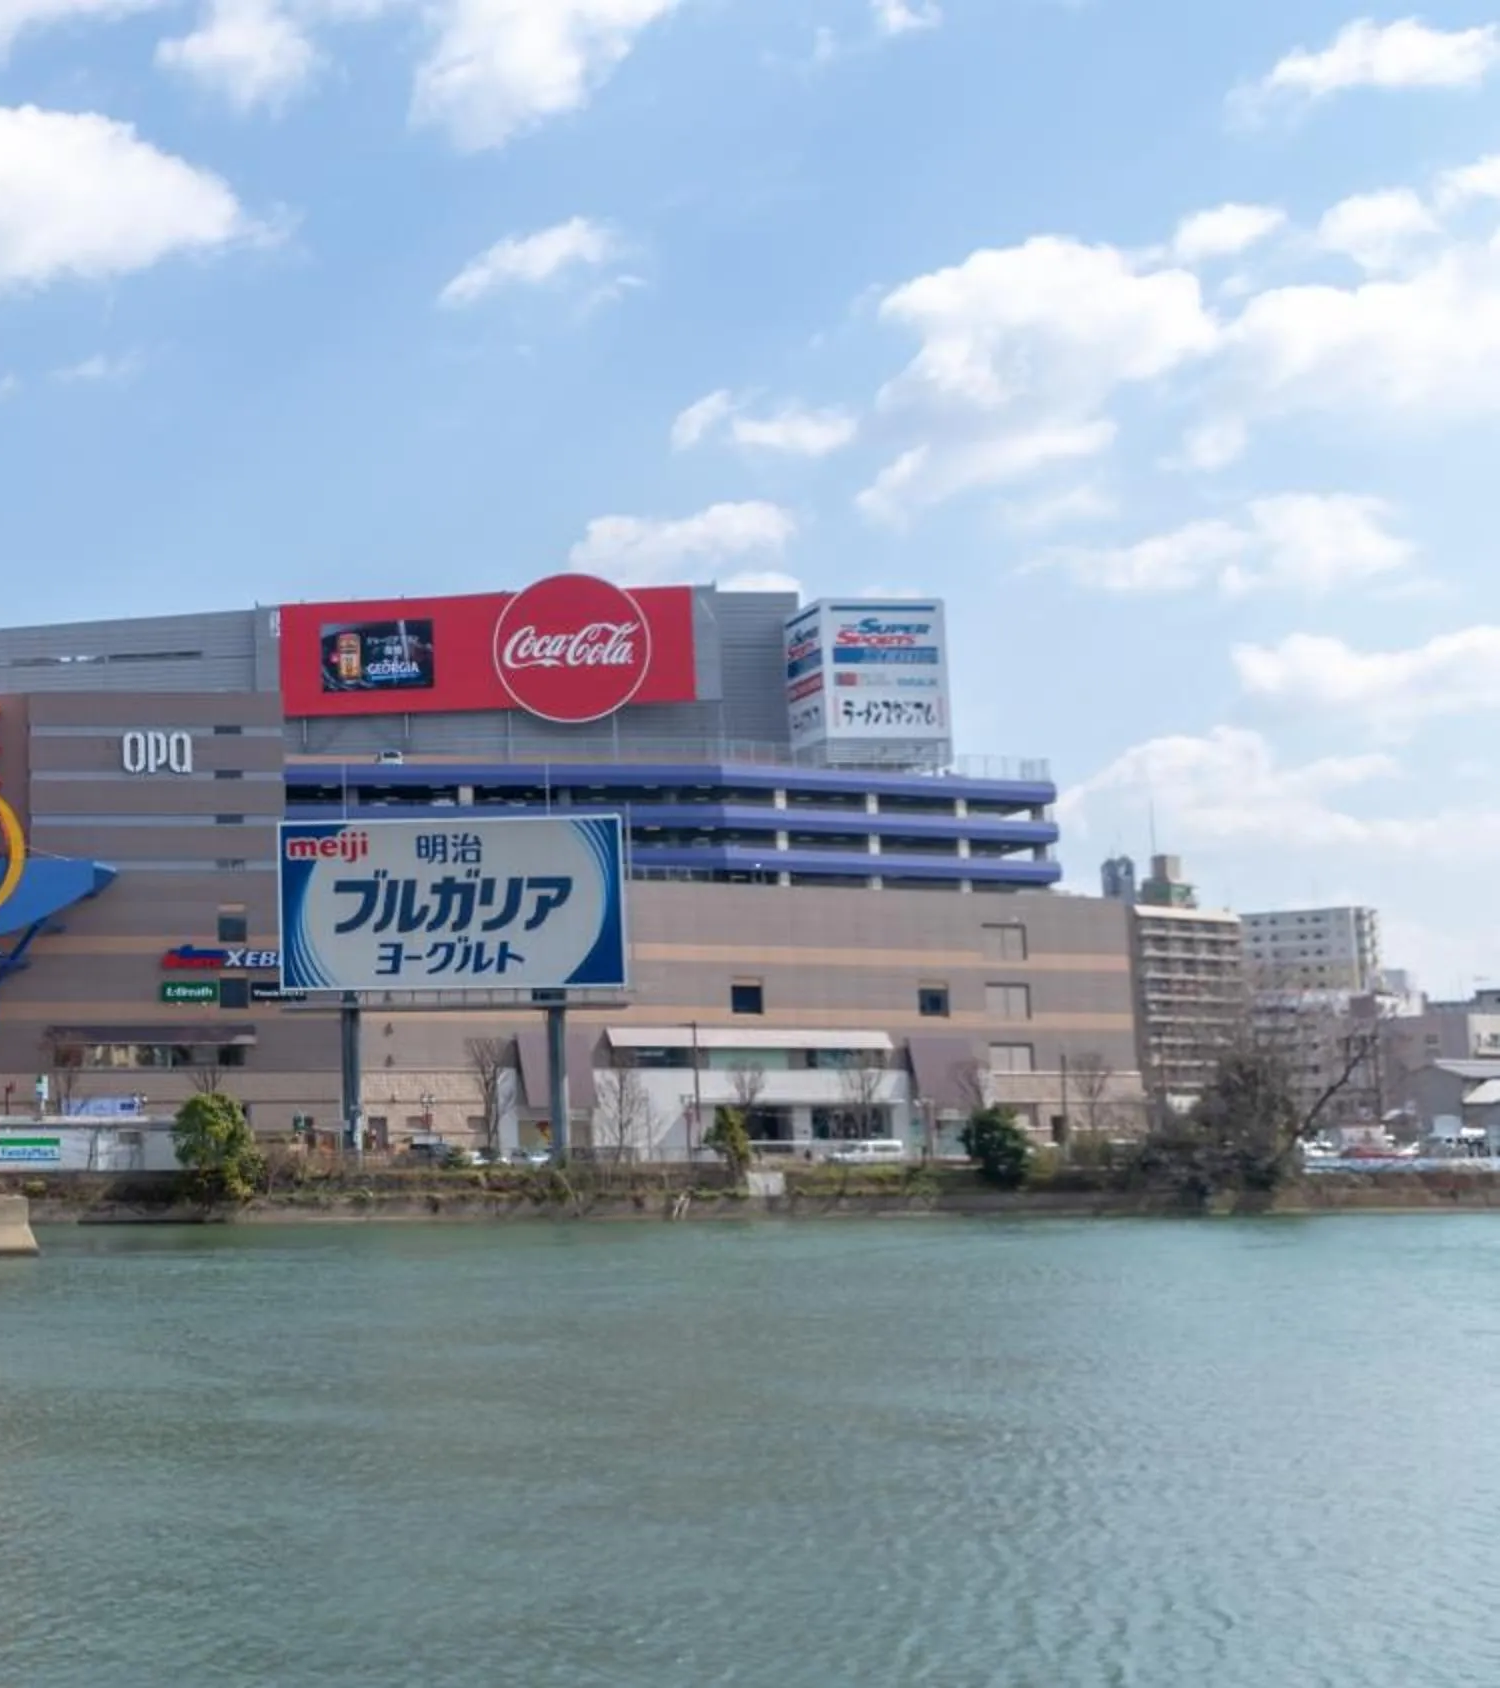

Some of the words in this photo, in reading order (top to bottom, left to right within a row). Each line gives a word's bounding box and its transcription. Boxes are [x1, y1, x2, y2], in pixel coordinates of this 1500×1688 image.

[503, 622, 640, 669] Coca-Cola
[286, 832, 369, 862] meiji
[415, 832, 483, 864] 明治
[333, 869, 573, 935] ブルガリア
[224, 948, 281, 967] XEB
[375, 936, 526, 975] ヨーグルト
